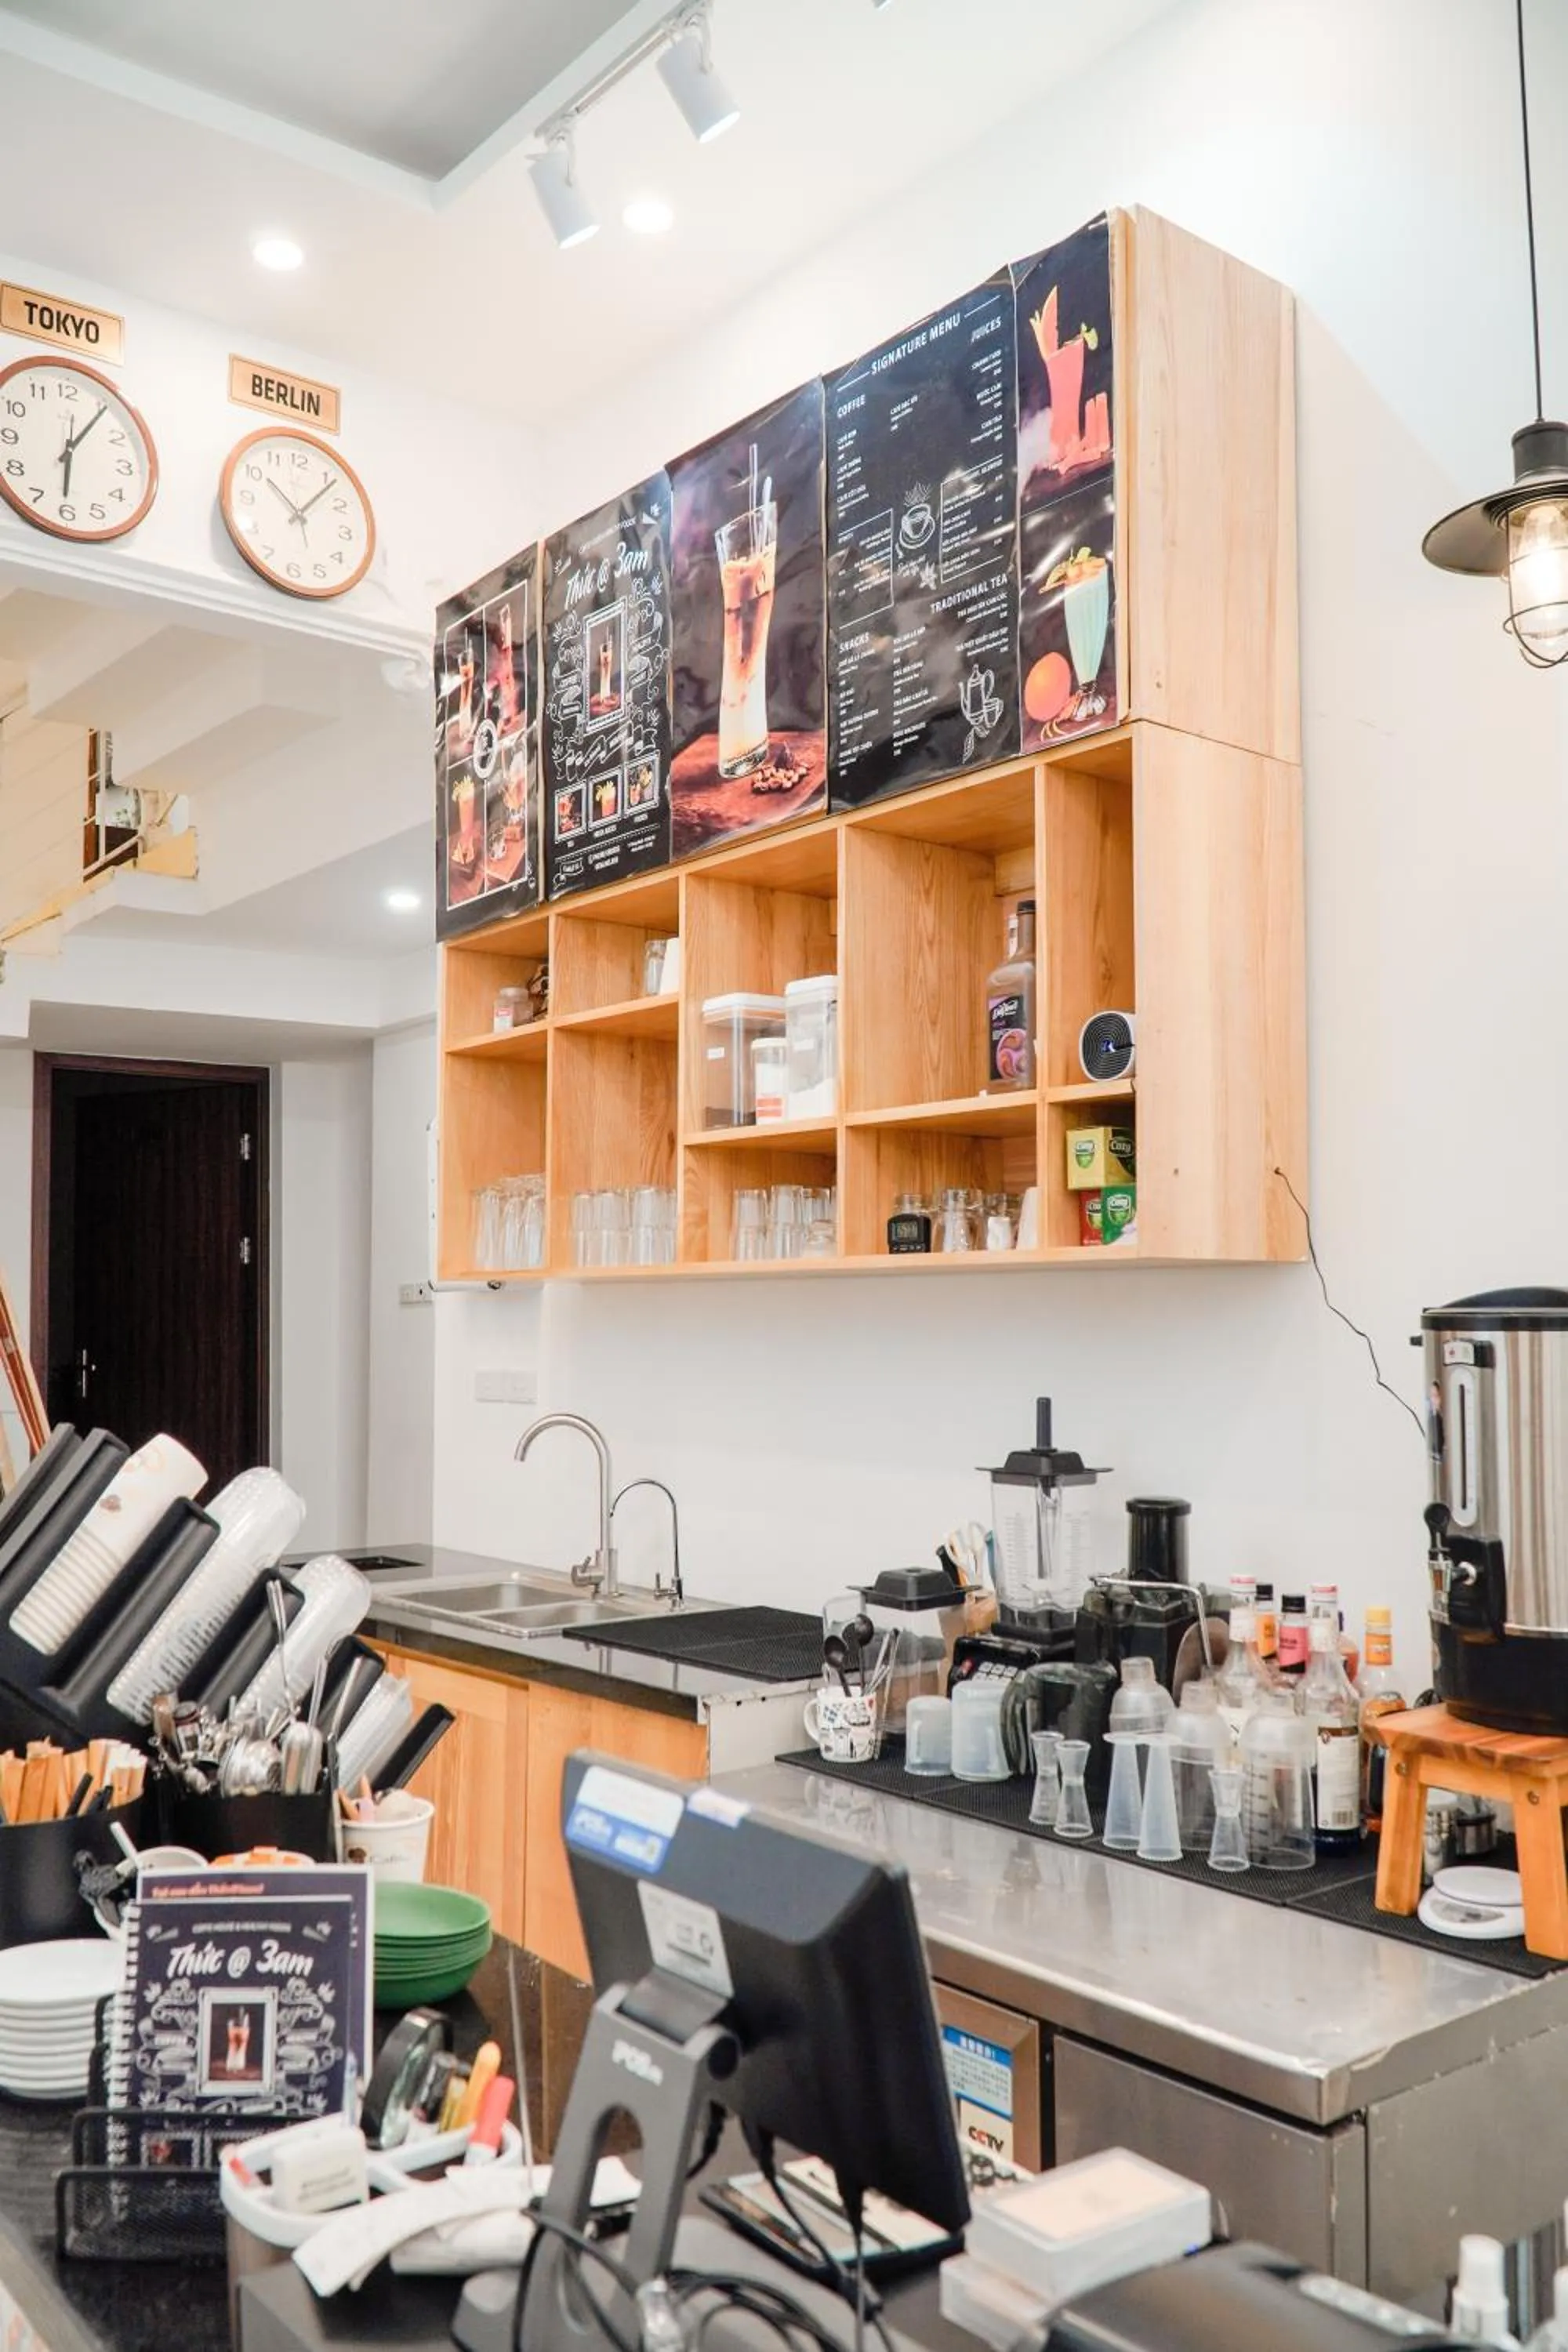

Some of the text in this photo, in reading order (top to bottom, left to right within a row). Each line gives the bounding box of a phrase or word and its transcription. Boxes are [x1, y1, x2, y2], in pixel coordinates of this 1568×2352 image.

[24, 301, 100, 344] TOKYO
[971, 316, 1002, 343] JUICES
[871, 313, 961, 375] SIGNATURE MENU
[58, 383, 78, 401] 12
[251, 373, 321, 417] BERLIN
[837, 394, 866, 419] COFFEE
[6, 399, 26, 418] 10
[615, 542, 648, 579] 3am
[930, 581, 989, 614] TRADITIONAL
[990, 573, 1008, 591] TEA
[839, 632, 869, 654] SNACKS
[227, 1946, 252, 1979] @
[256, 1938, 314, 1978] 3am
[968, 2125, 1004, 2152] CCTV
